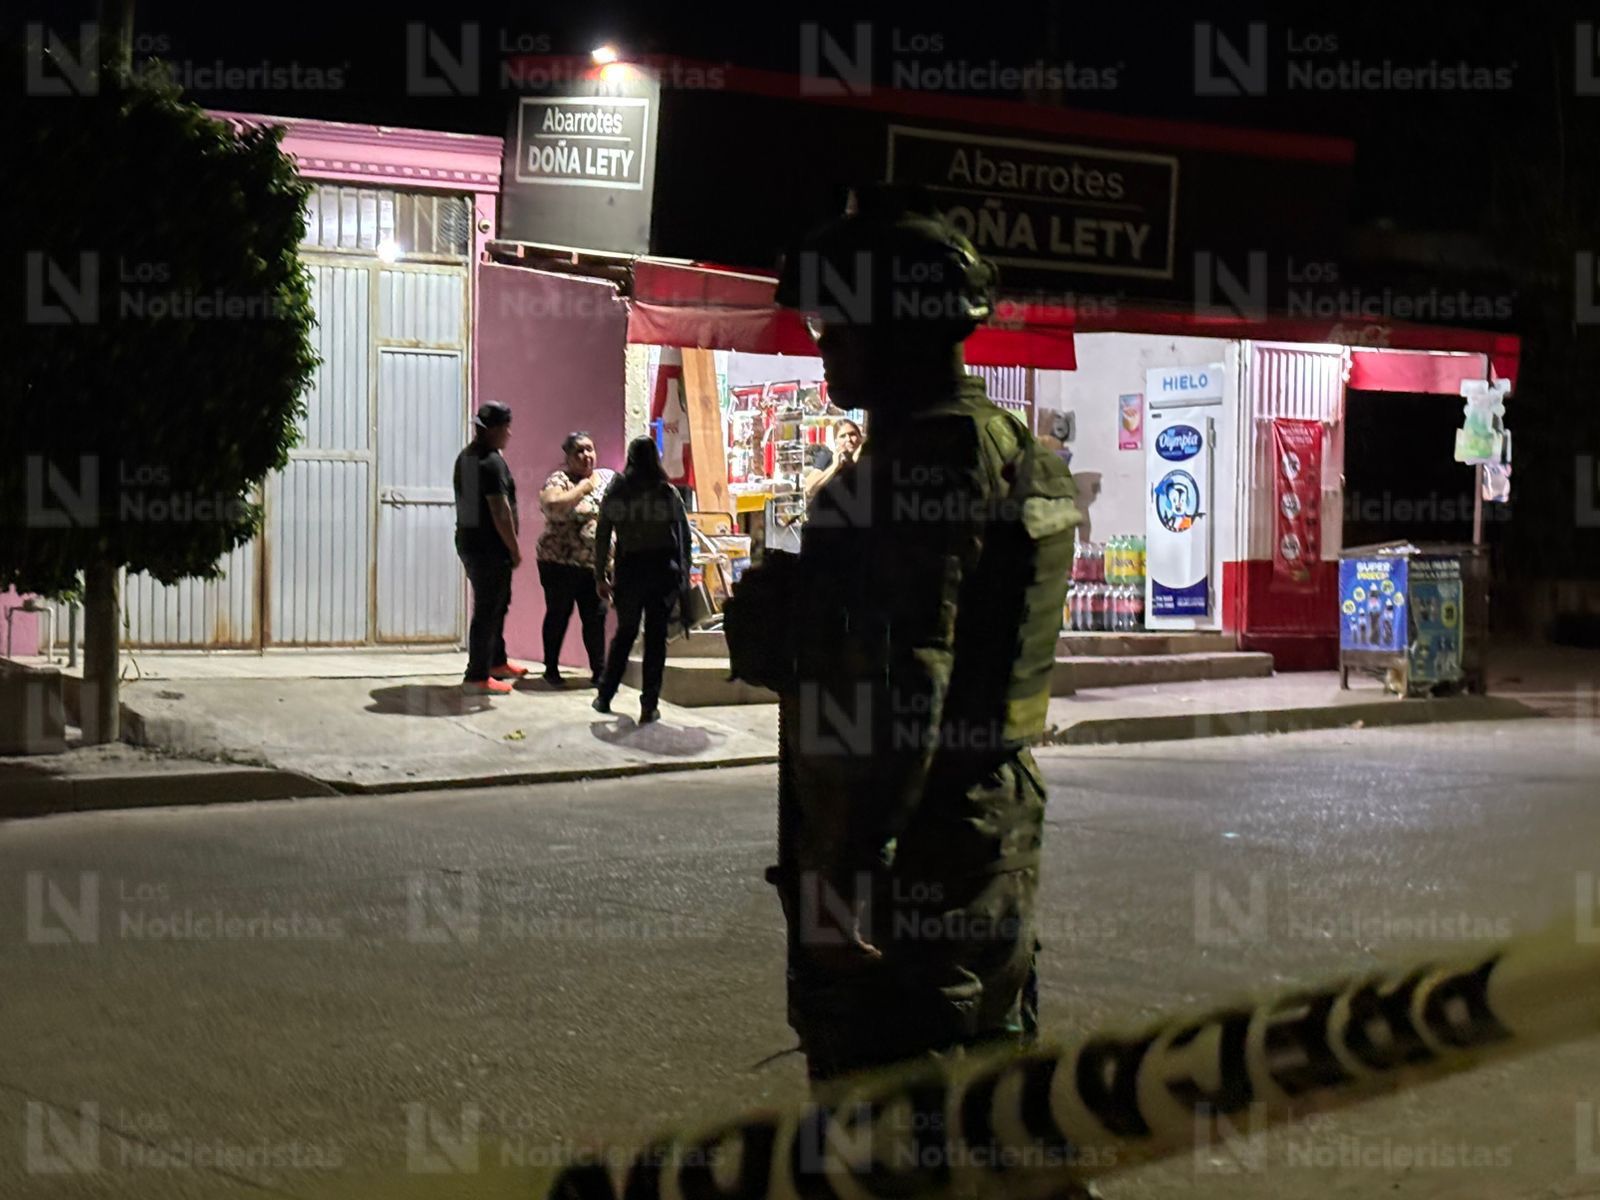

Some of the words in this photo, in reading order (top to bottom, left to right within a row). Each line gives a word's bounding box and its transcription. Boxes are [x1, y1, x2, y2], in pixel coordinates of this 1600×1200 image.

[542, 106, 623, 134] Abarrotes
[528, 139, 581, 174] DOÑA
[585, 147, 634, 177] LETY
[946, 148, 1126, 200] Abarrotes
[945, 196, 1038, 252] OÑA
[1049, 215, 1151, 261] LETY
[1162, 373, 1209, 391] HIELO
[1159, 431, 1199, 452] Olympia
